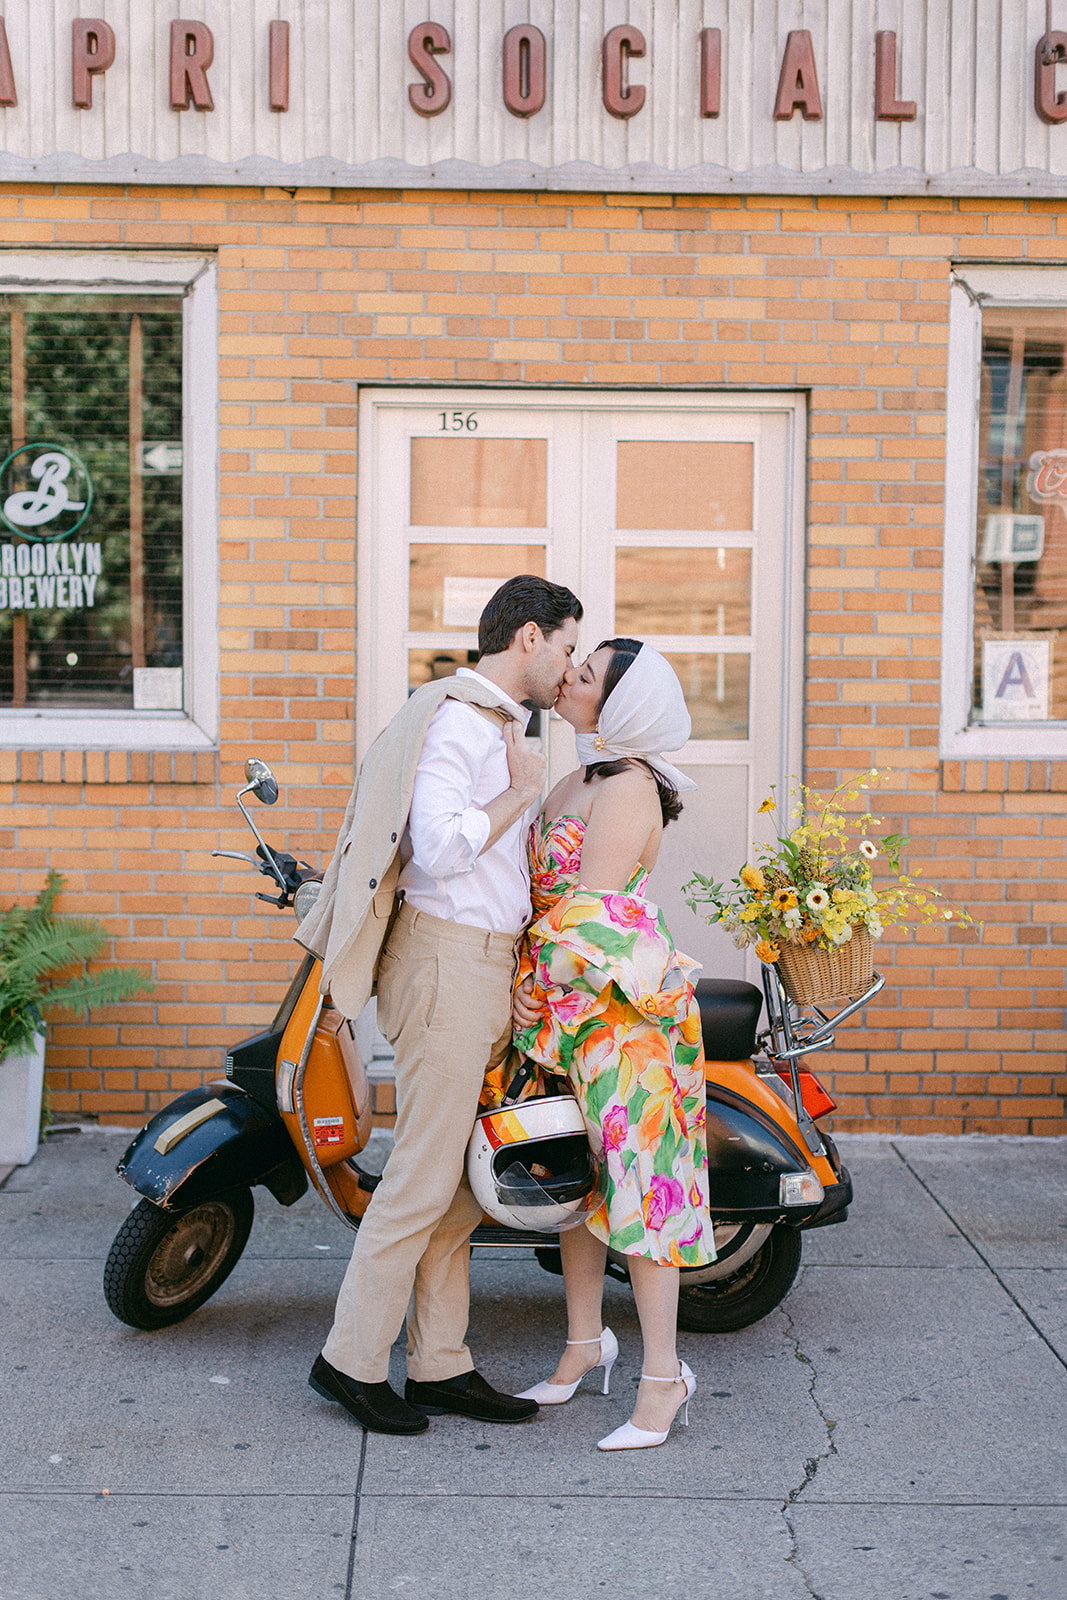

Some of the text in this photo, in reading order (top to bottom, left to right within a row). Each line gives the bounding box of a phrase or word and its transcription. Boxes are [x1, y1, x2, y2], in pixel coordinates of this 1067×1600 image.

[408, 21, 917, 122] SOCIAL
[438, 411, 479, 432] 156
[4, 452, 86, 527] B
[0, 542, 103, 577] ROOKLYN
[995, 651, 1037, 699] A
